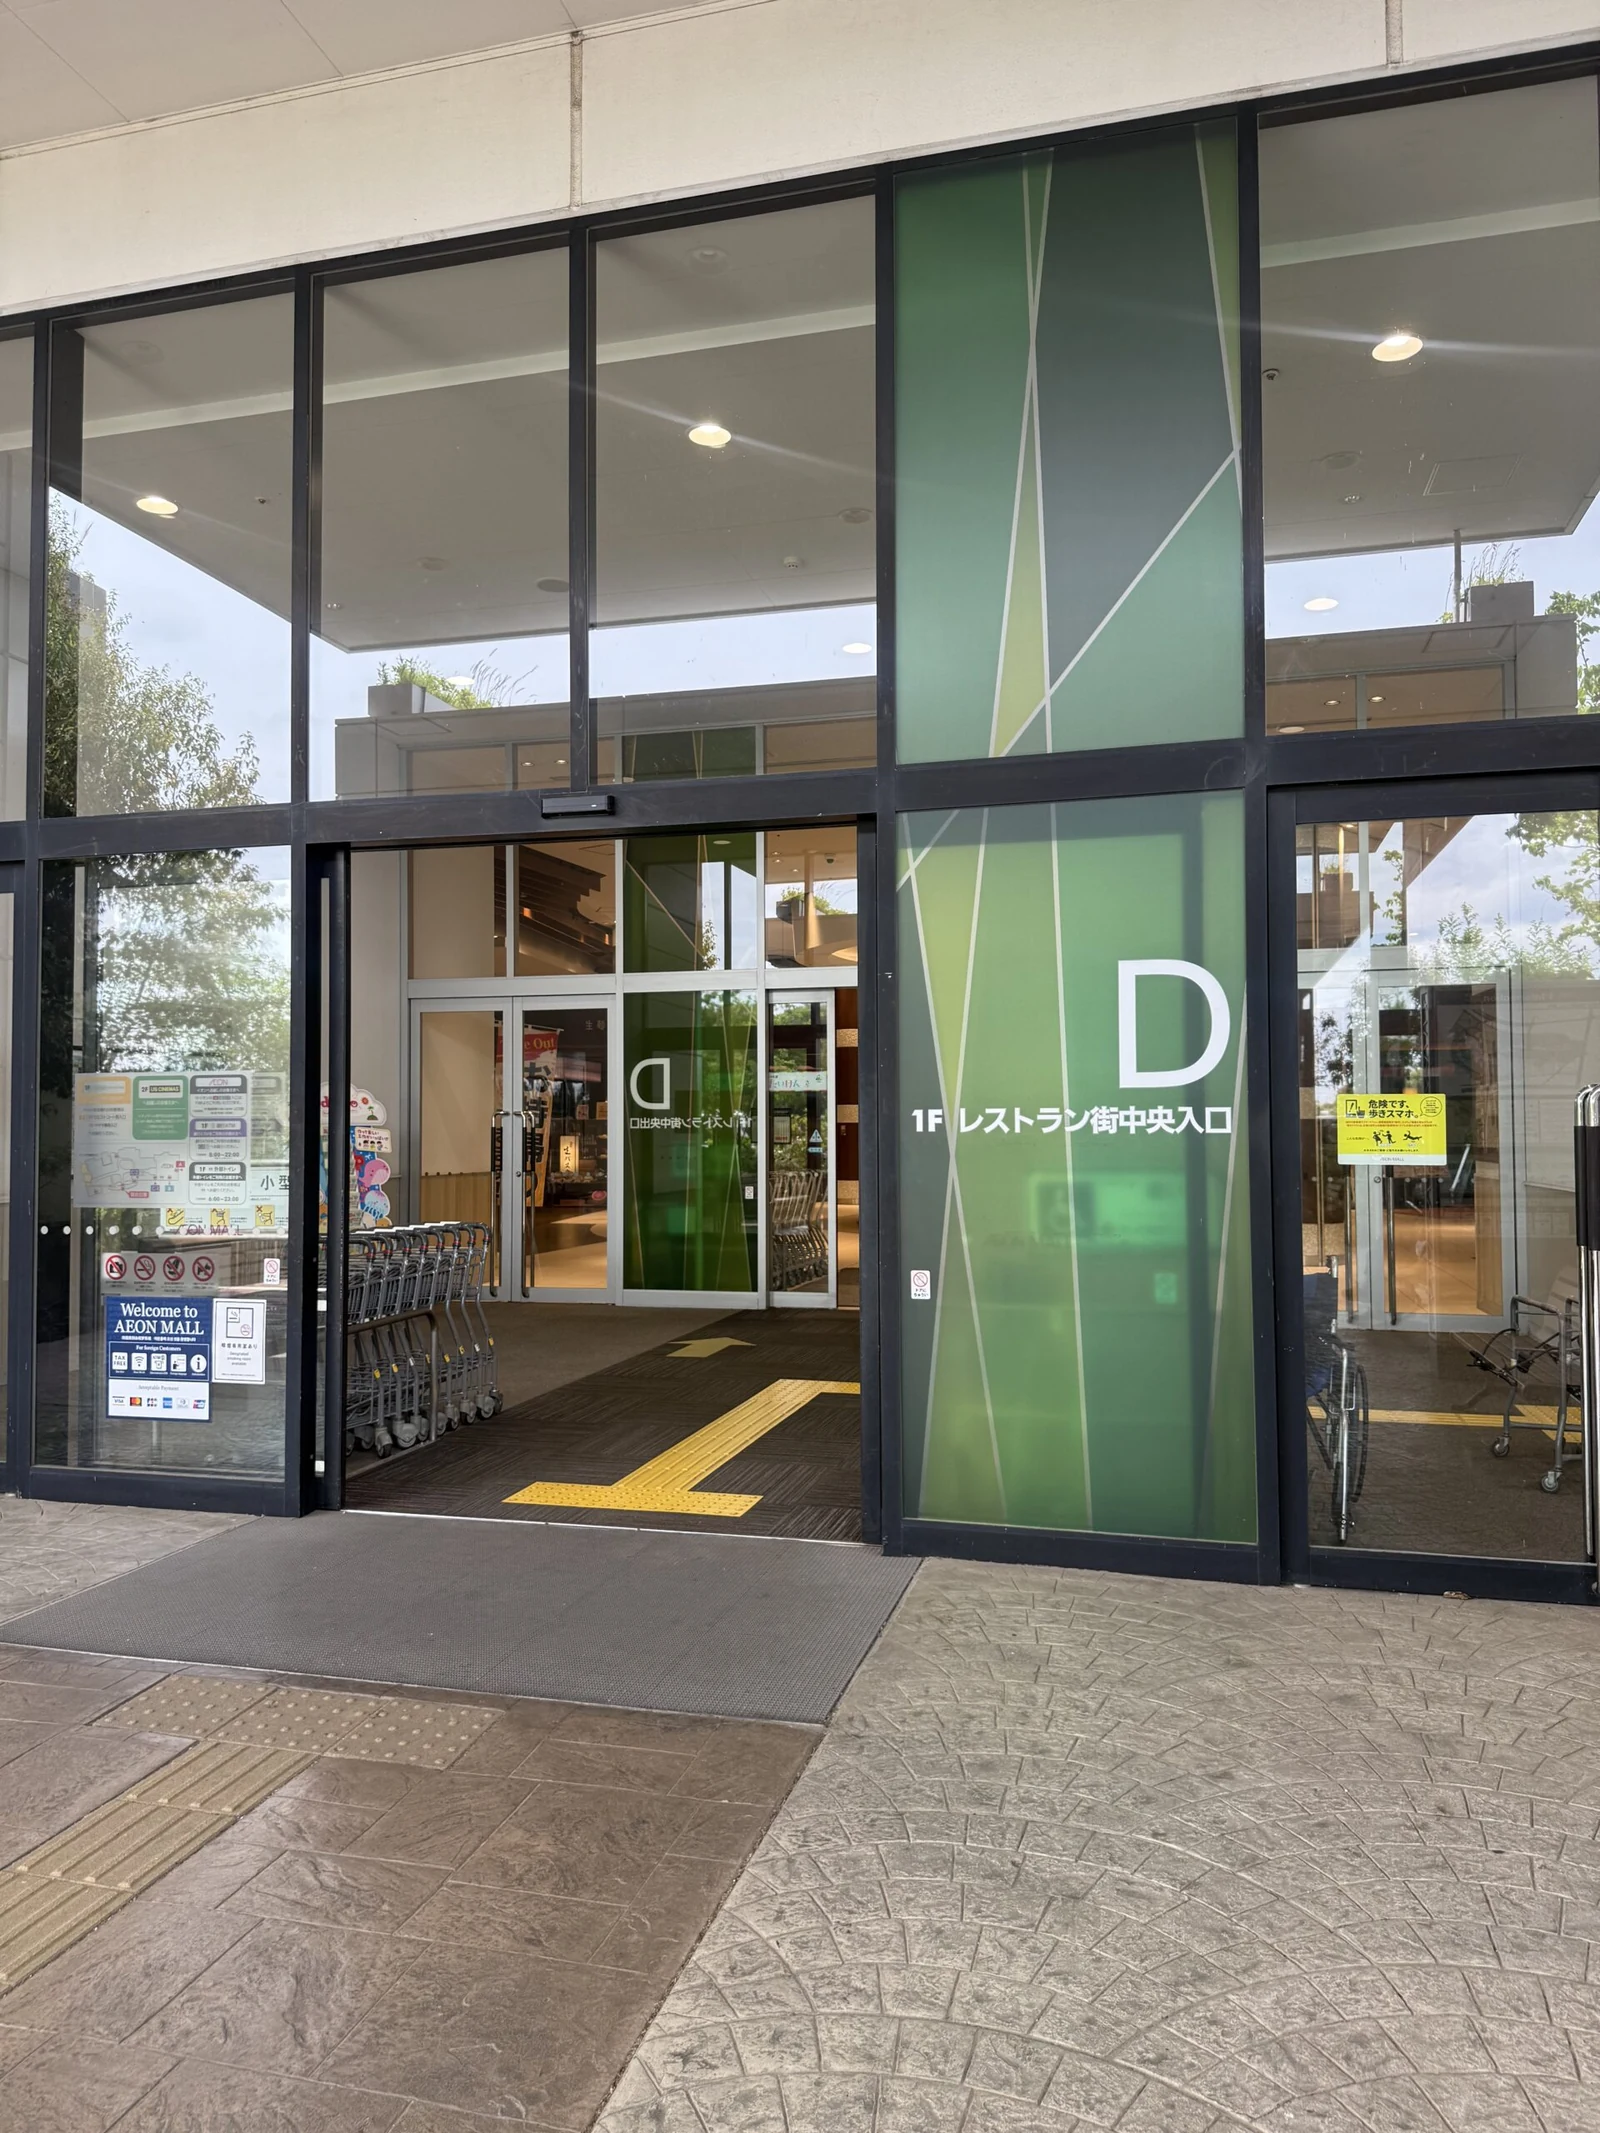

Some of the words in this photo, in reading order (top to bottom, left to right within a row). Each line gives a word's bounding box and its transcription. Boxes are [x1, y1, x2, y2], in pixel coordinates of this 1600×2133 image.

[1118, 959, 1230, 1088] D
[533, 1036, 555, 1049] Out
[1368, 1099, 1410, 1109] 危険です、
[911, 1109, 943, 1132] 1F
[959, 1105, 1232, 1134] レストラン街中央入口
[1368, 1109, 1419, 1119] 歩きスマホ。
[120, 1302, 181, 1318] Welcome
[183, 1305, 198, 1318] to
[114, 1319, 158, 1334] AEON
[160, 1320, 205, 1335] MALL
